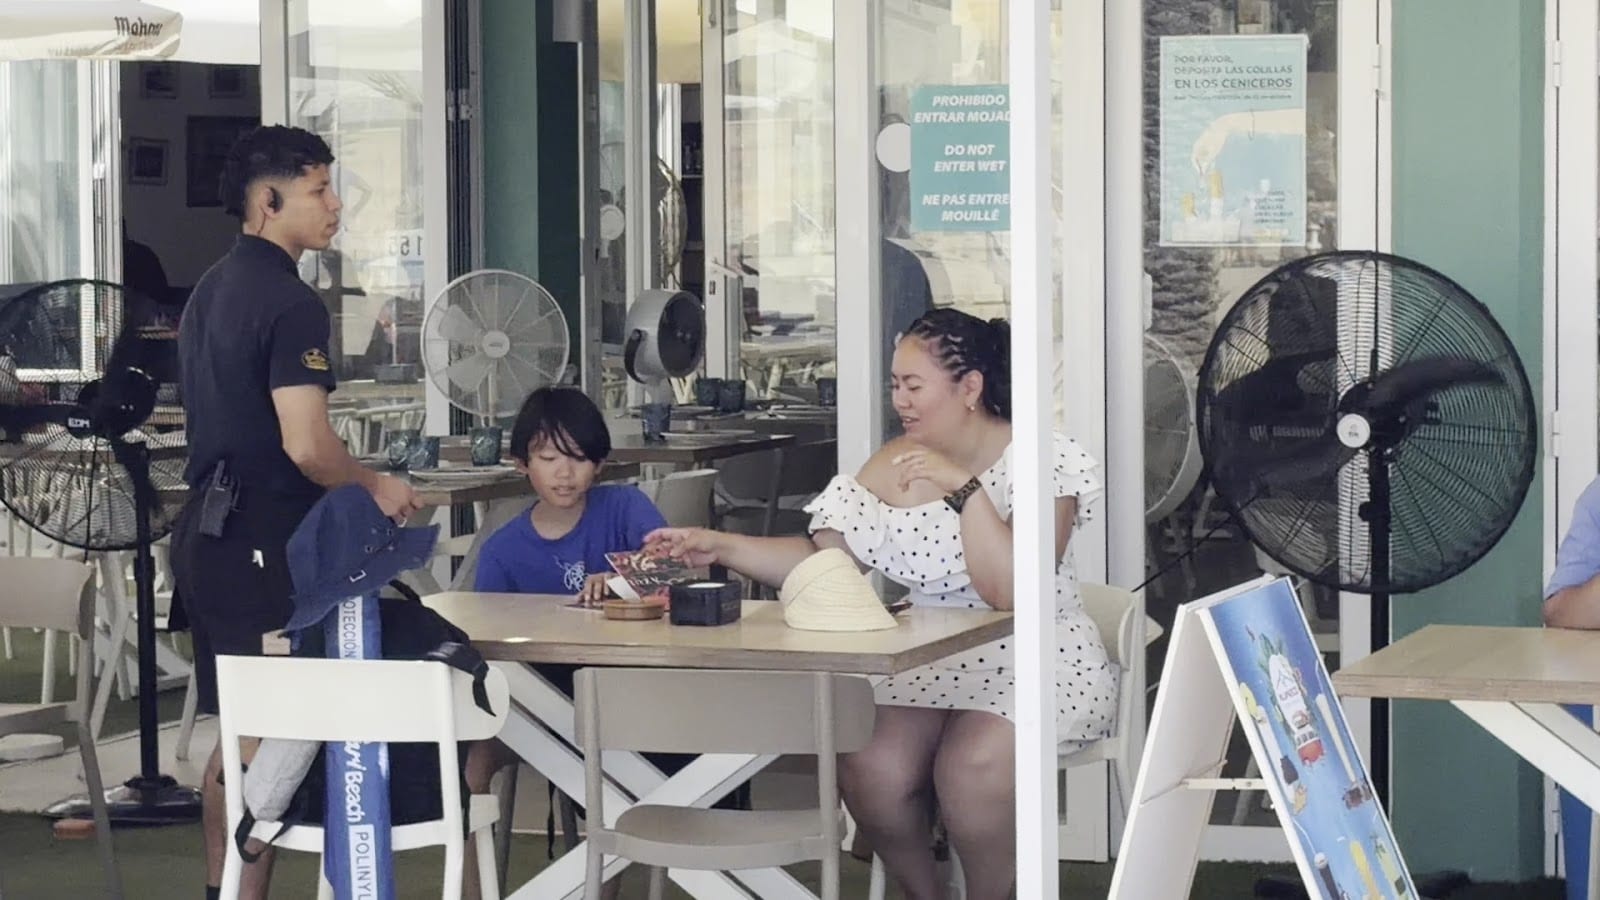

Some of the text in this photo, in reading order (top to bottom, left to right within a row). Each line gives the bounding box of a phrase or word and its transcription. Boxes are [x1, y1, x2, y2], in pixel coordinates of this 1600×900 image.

[1225, 66, 1244, 74] LAS
[1246, 65, 1293, 74] COLILLAS
[1174, 78, 1293, 88] EN LOS CENICEROS
[932, 94, 1006, 107] PROHIBIDO
[914, 111, 965, 123] ENTRAR
[944, 144, 996, 156] DO NOT
[934, 160, 1007, 172] ENTER WET
[922, 193, 1010, 206] NE PAS ENTRE
[942, 208, 1000, 221] MOUILLÉ
[343, 600, 359, 658] OTECCIÓN
[344, 770, 366, 823] Beach
